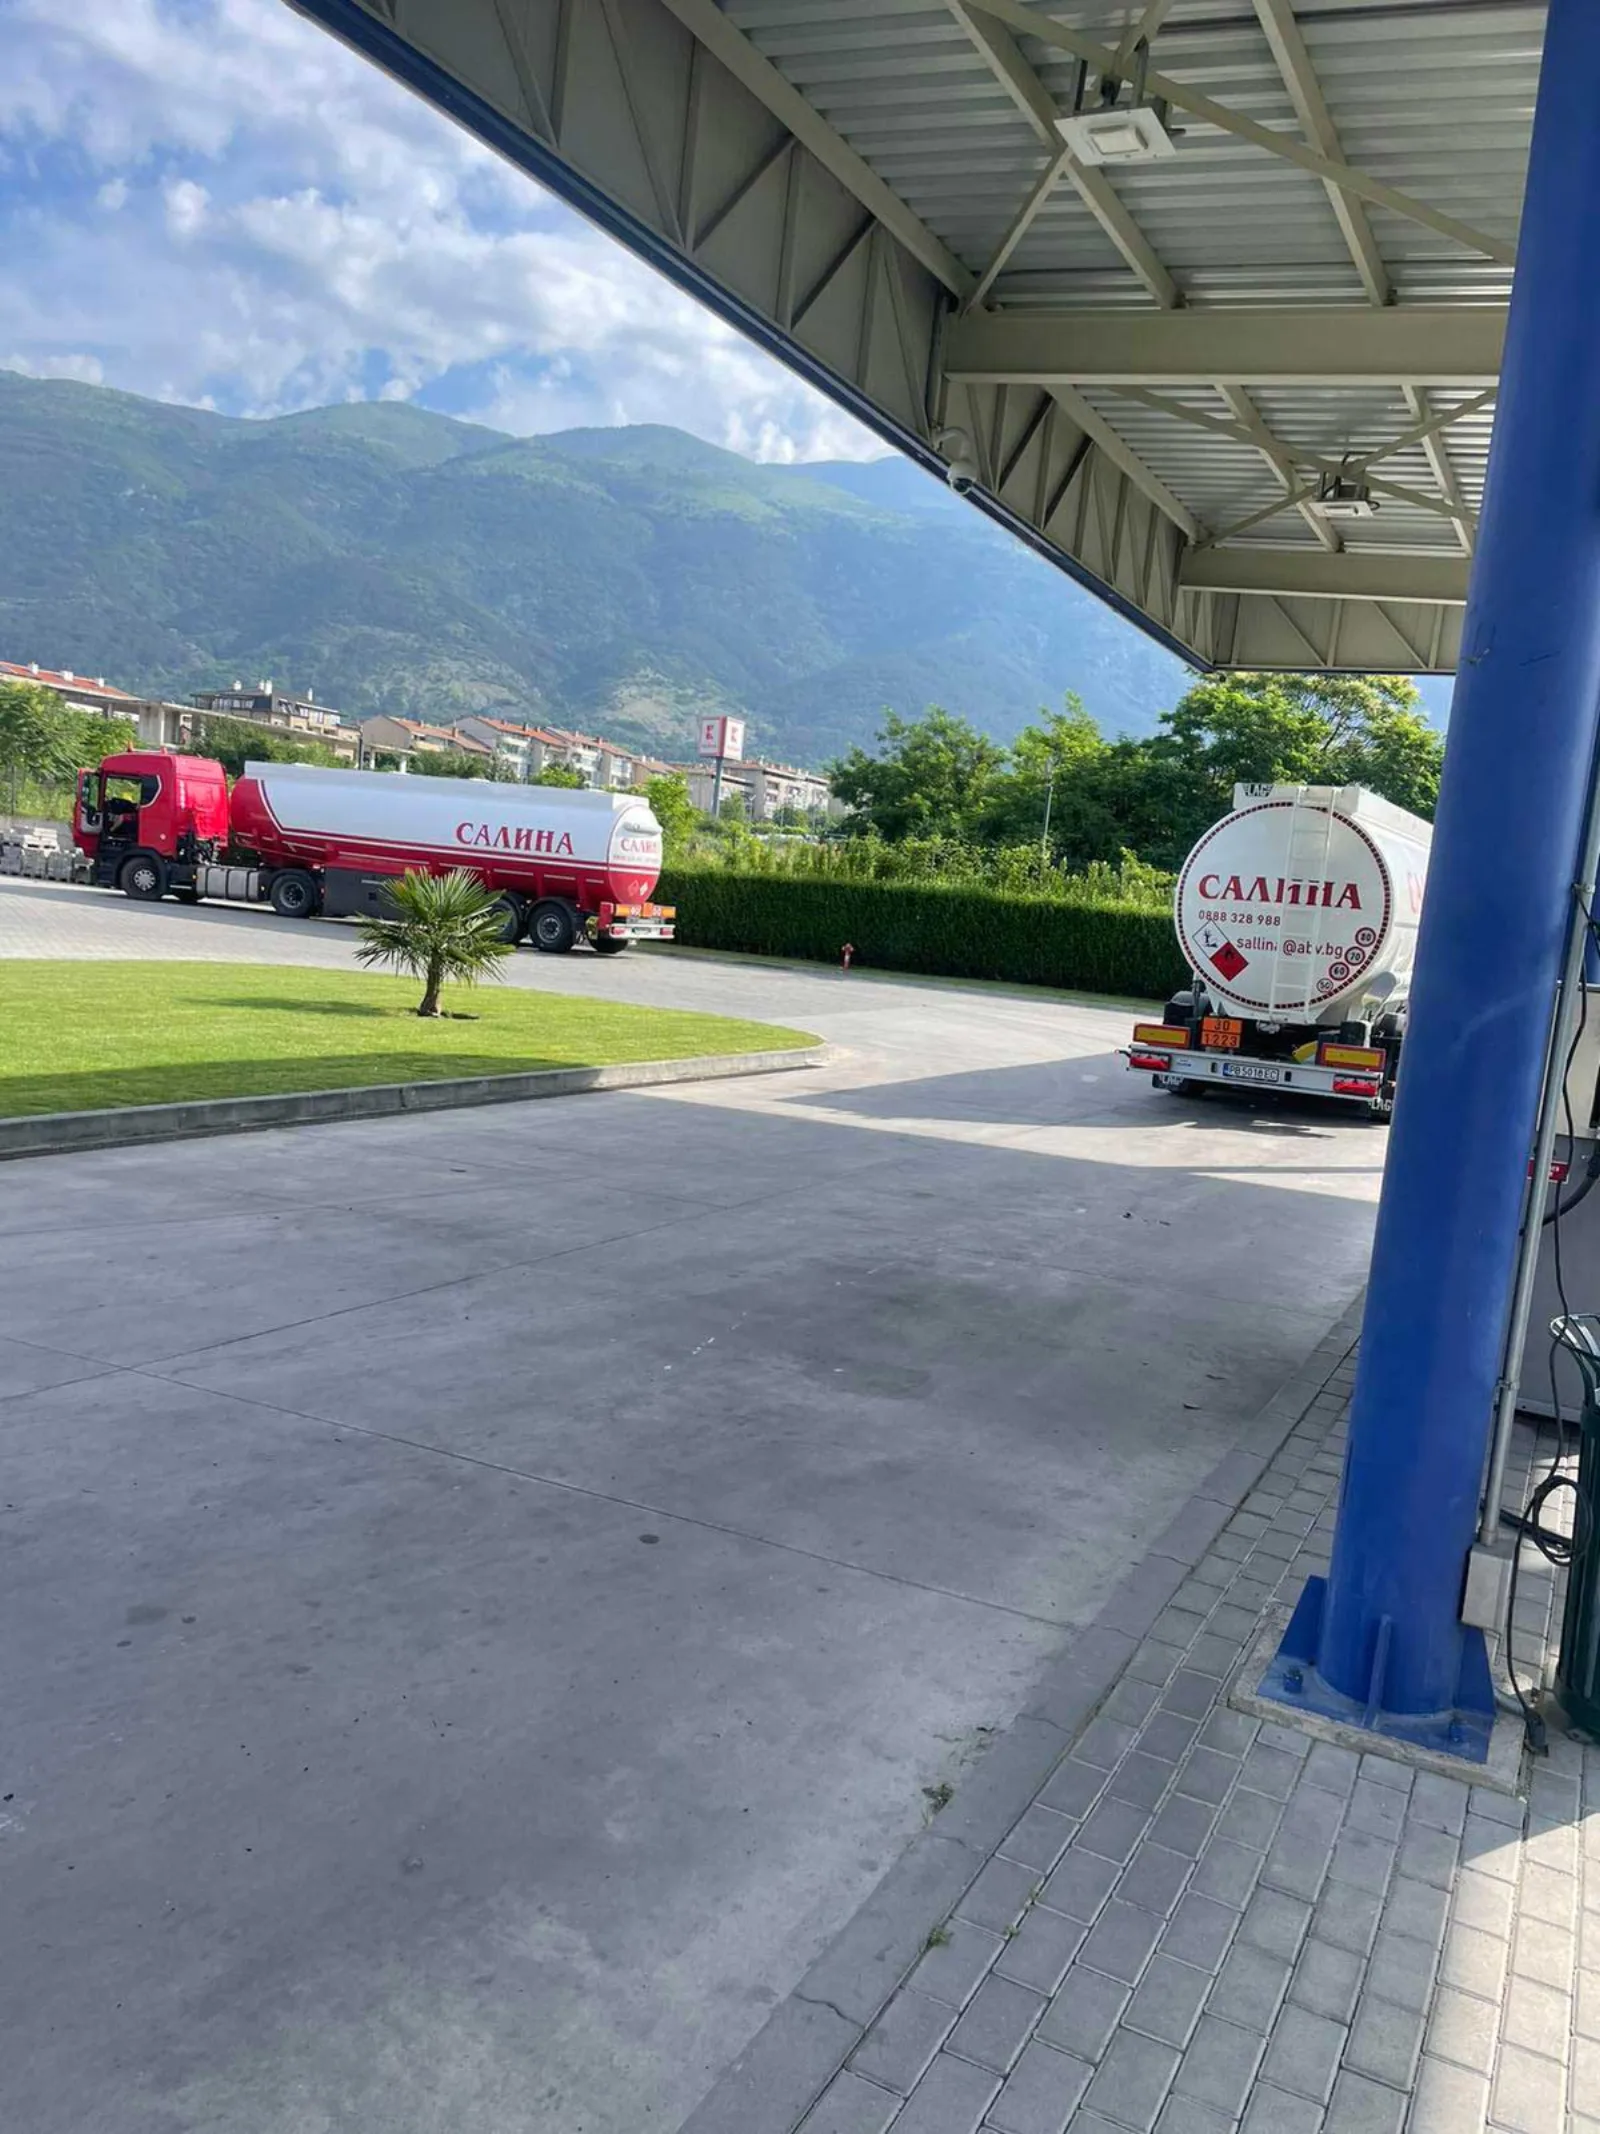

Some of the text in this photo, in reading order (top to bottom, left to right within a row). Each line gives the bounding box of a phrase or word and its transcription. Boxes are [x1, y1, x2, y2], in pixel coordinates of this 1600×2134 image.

[456, 822, 574, 855] САЛИНА
[1198, 910, 1281, 926] 0888 328 988
[1214, 1020, 1230, 1031] 30
[1204, 1033, 1238, 1047] 1223
